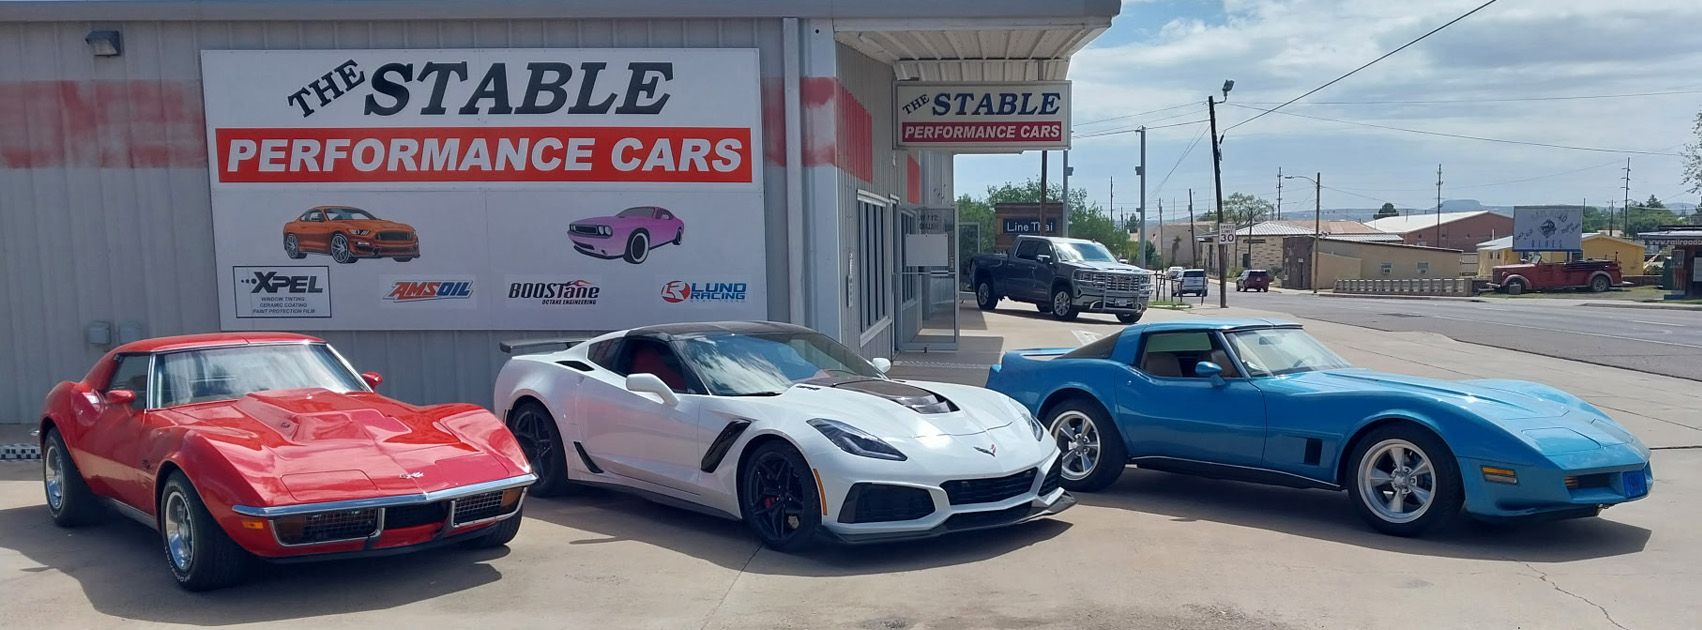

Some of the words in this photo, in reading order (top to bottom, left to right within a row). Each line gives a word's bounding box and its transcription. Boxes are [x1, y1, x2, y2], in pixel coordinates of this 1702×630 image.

[287, 58, 366, 118] THE
[363, 61, 674, 116] STABLE
[902, 94, 930, 115] THE
[932, 92, 1061, 116] STABLE
[904, 125, 1016, 139] PERFORMANCE
[1020, 124, 1060, 138] CARS
[227, 137, 596, 172] PERFORMANCE
[611, 137, 743, 173] CARS
[1006, 221, 1029, 232] Line
[1220, 234, 1234, 242] 30
[250, 271, 323, 293] XPEL
[691, 282, 747, 293] LUND
[386, 281, 472, 301] AMSOIL
[690, 292, 746, 300] RACING
